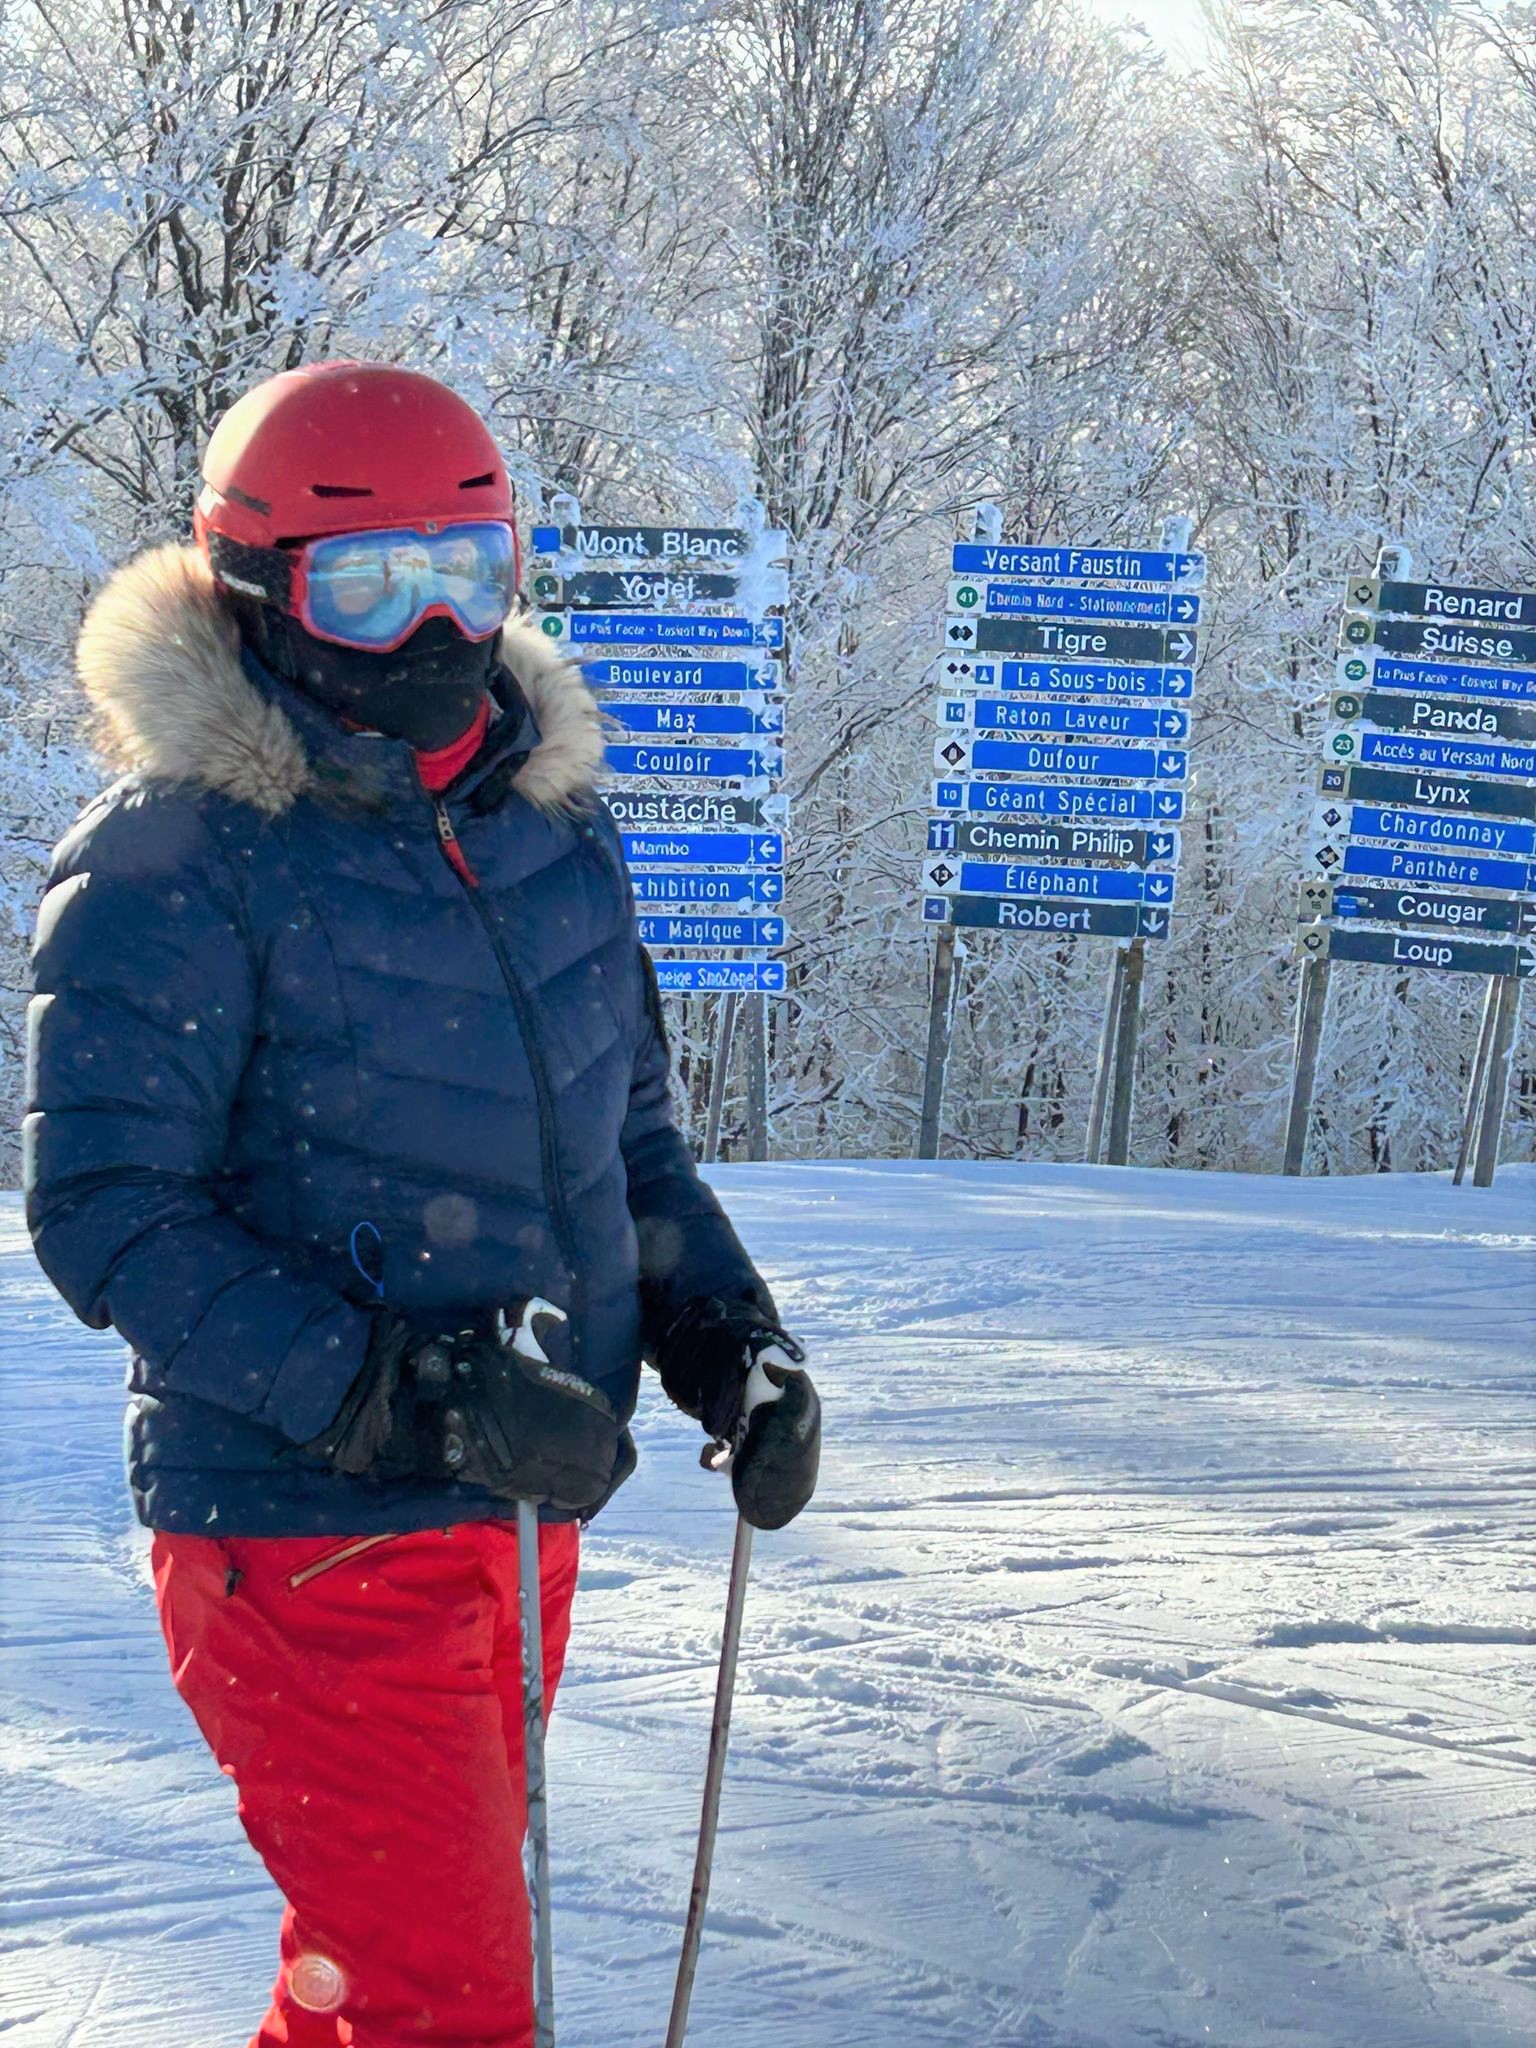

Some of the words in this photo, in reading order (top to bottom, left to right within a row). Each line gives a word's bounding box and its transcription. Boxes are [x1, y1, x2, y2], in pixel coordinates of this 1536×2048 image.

[576, 531, 645, 554] Mont
[663, 532, 738, 555] Blanc
[986, 549, 1060, 573] Versant
[1069, 552, 1141, 577] Faustin
[620, 575, 694, 600] Yodel
[1424, 589, 1523, 619] Renard
[1037, 626, 1107, 656] Tigre
[1421, 627, 1514, 657] Suisse
[610, 666, 702, 685] Boulevard
[1018, 667, 1040, 687] La
[1050, 668, 1146, 693] Sous-bois
[657, 709, 696, 729] Max
[996, 706, 1051, 726] Raton
[1065, 709, 1130, 731] Laveur
[1412, 702, 1498, 733] Panda
[636, 751, 712, 772] Couloir
[1028, 747, 1100, 771] Dufour
[1372, 740, 1415, 760] Accès
[1419, 748, 1436, 761] au
[1441, 747, 1496, 767] Versant
[1500, 752, 1535, 770] Nord
[985, 787, 1045, 811] Géant
[1058, 789, 1136, 815] Spécial
[1414, 778, 1471, 804] Lynx
[931, 823, 955, 849] 11
[969, 826, 1060, 851] Chemin
[1072, 831, 1134, 857] Philip
[1379, 812, 1505, 849] Chardonnay
[631, 840, 690, 856] Mambo
[1006, 866, 1099, 895] Éléphant
[1391, 855, 1479, 881] Panthère
[631, 878, 730, 897] xhibition
[999, 902, 1092, 930] Robert
[1397, 895, 1487, 924] Cougar
[669, 920, 742, 944] Magique
[1393, 939, 1453, 966] Loup
